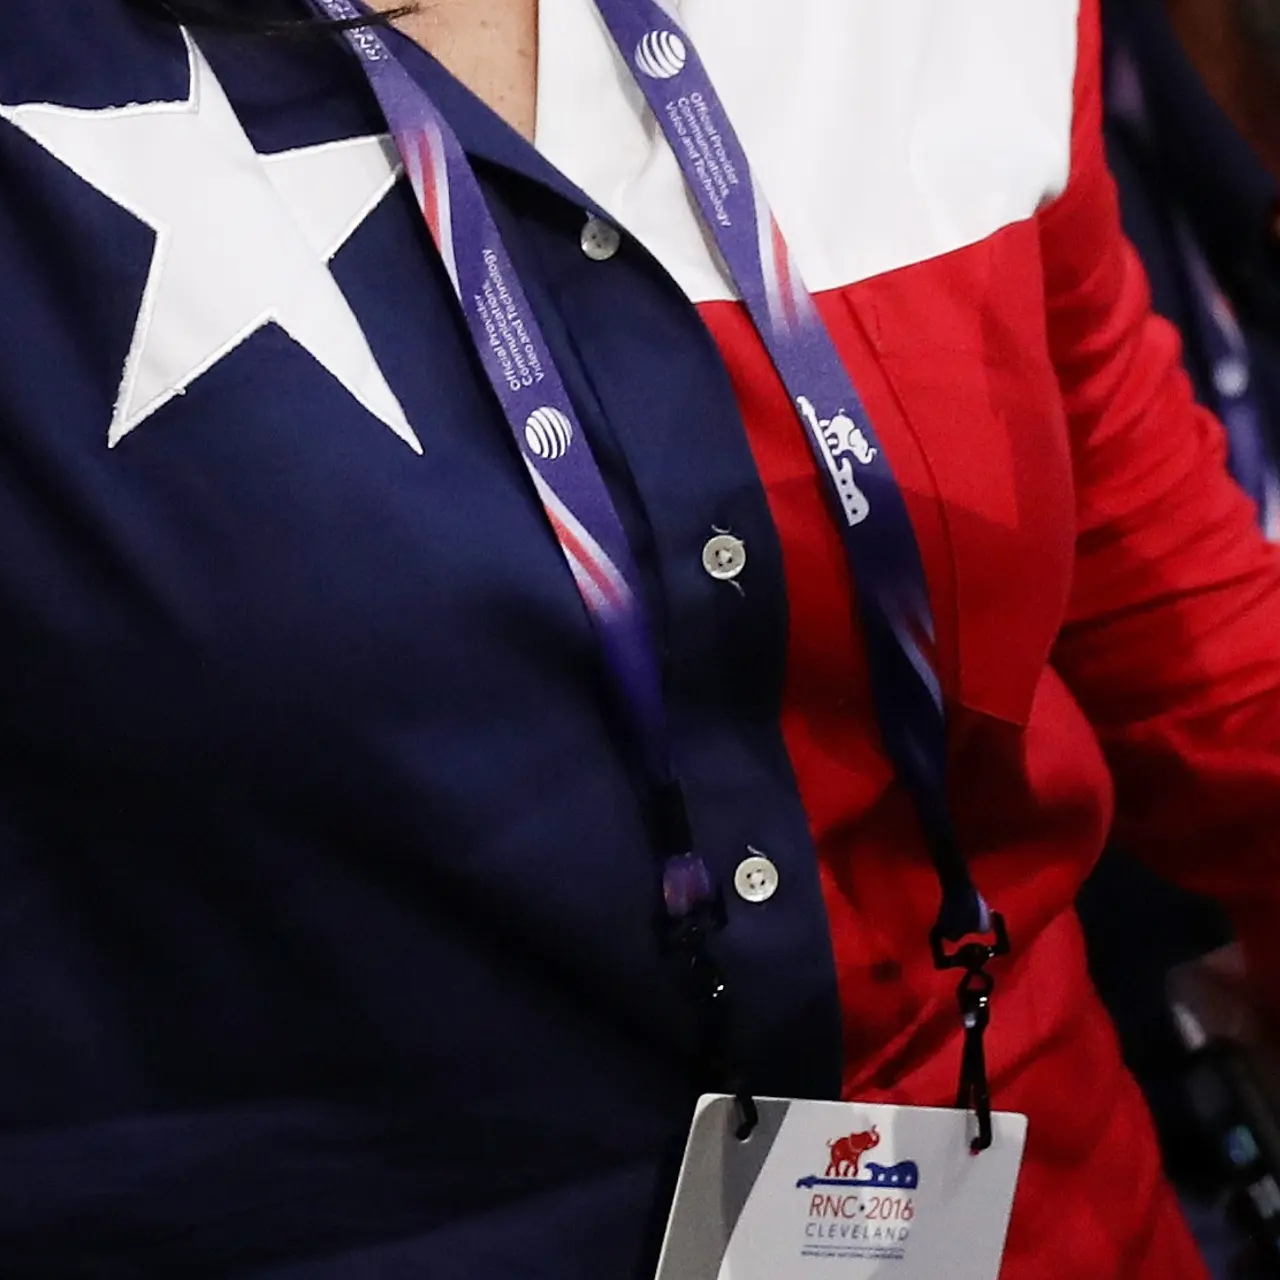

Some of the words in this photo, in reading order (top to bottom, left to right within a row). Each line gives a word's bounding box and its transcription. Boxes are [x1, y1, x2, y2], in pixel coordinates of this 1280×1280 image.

[690, 92, 718, 137] Official
[713, 135, 739, 185] Provider
[665, 101, 687, 137] Video
[681, 136, 701, 161] and
[694, 157, 732, 227] Technology
[482, 248, 518, 320] Technology
[474, 294, 501, 347] Provider
[512, 319, 531, 345] and
[493, 345, 521, 391] Official
[524, 344, 545, 383] Video
[805, 1222, 910, 1241] CLEVELAND
